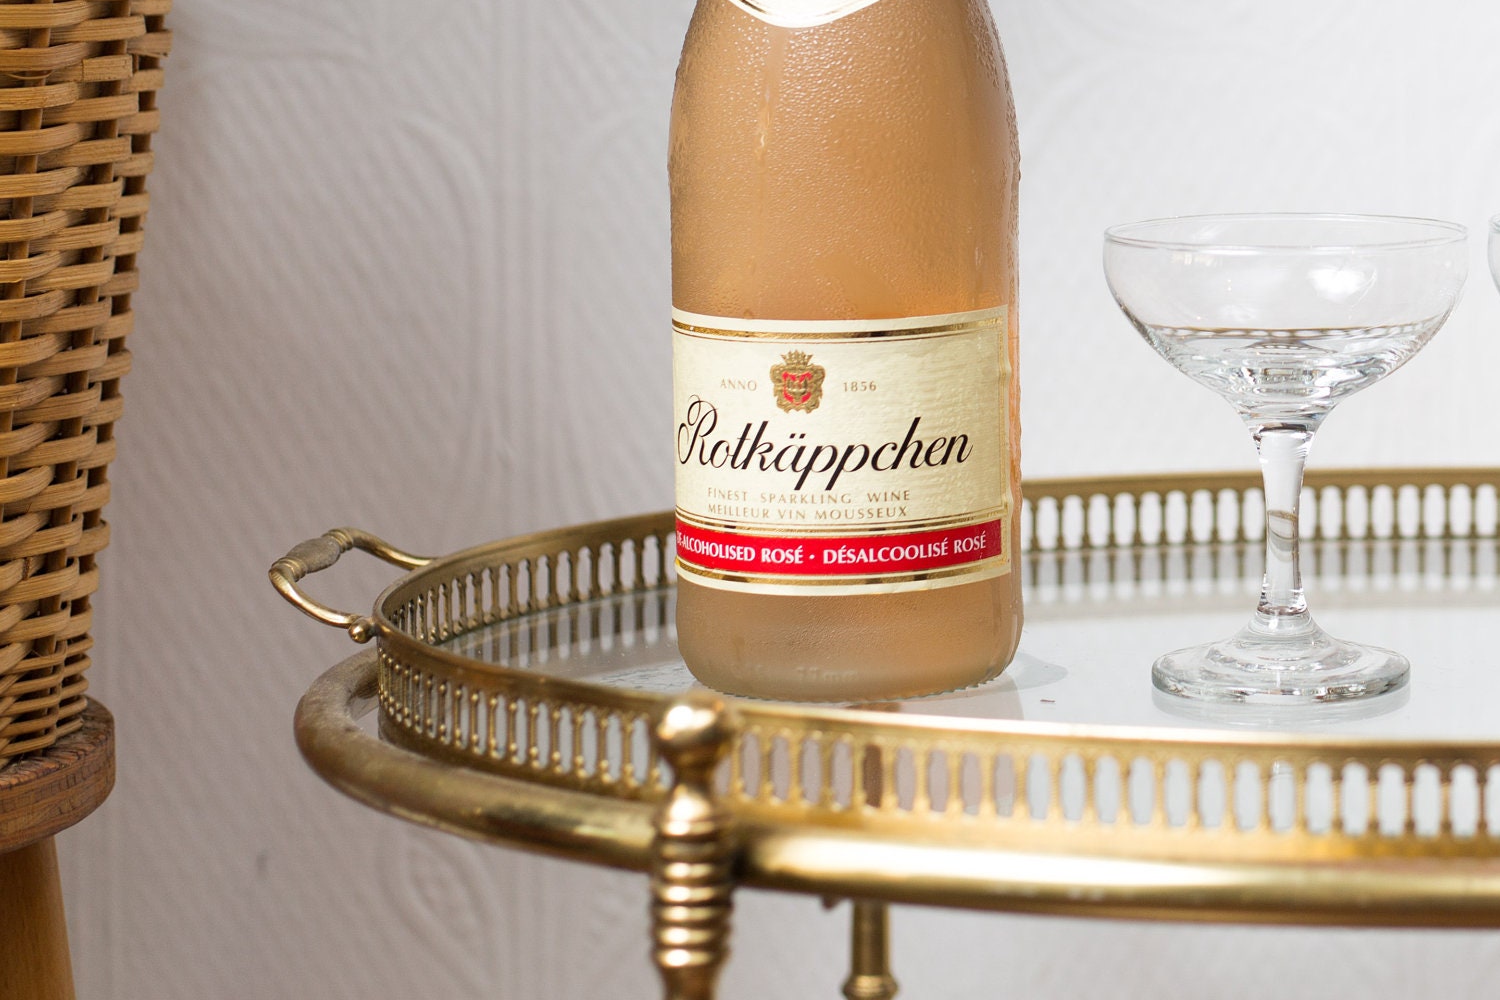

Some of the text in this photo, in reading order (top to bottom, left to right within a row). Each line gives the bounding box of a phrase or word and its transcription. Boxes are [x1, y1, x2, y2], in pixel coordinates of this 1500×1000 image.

[720, 378, 877, 393] ANNO 1856
[677, 394, 973, 491] Rotkäppchen
[707, 487, 911, 505] FINEST SPARKLING WINE
[708, 503, 908, 520] MEILLEUR VIN MOUSSEUX
[761, 545, 804, 564] ROSÉ
[823, 537, 949, 565] DÉSALCOOLISÉ
[953, 530, 987, 554] ROSÉ
